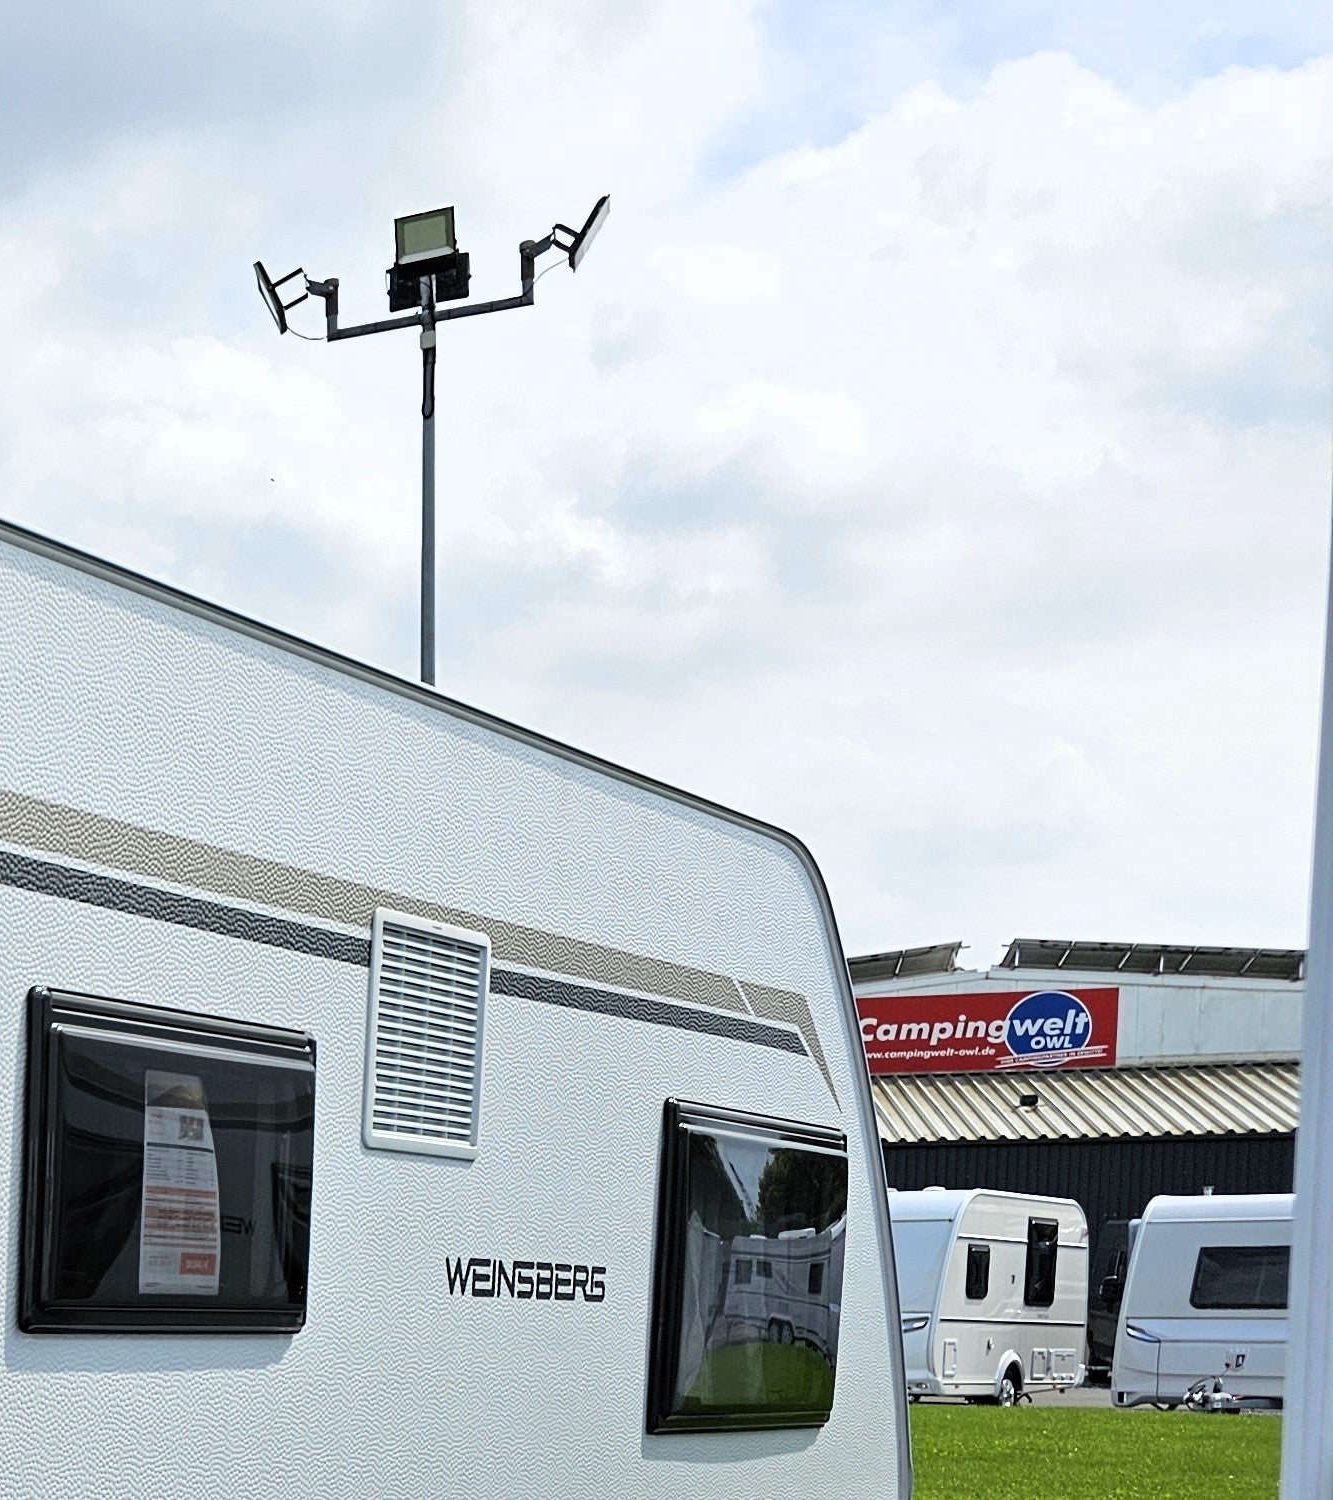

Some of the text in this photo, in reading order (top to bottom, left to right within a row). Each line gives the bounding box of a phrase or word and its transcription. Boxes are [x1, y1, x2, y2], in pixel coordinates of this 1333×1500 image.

[1030, 1036, 1073, 1049] OWL
[866, 1047, 996, 1060] ww.campingwelt-owl.de
[445, 1256, 607, 1302] WEINSBERG
